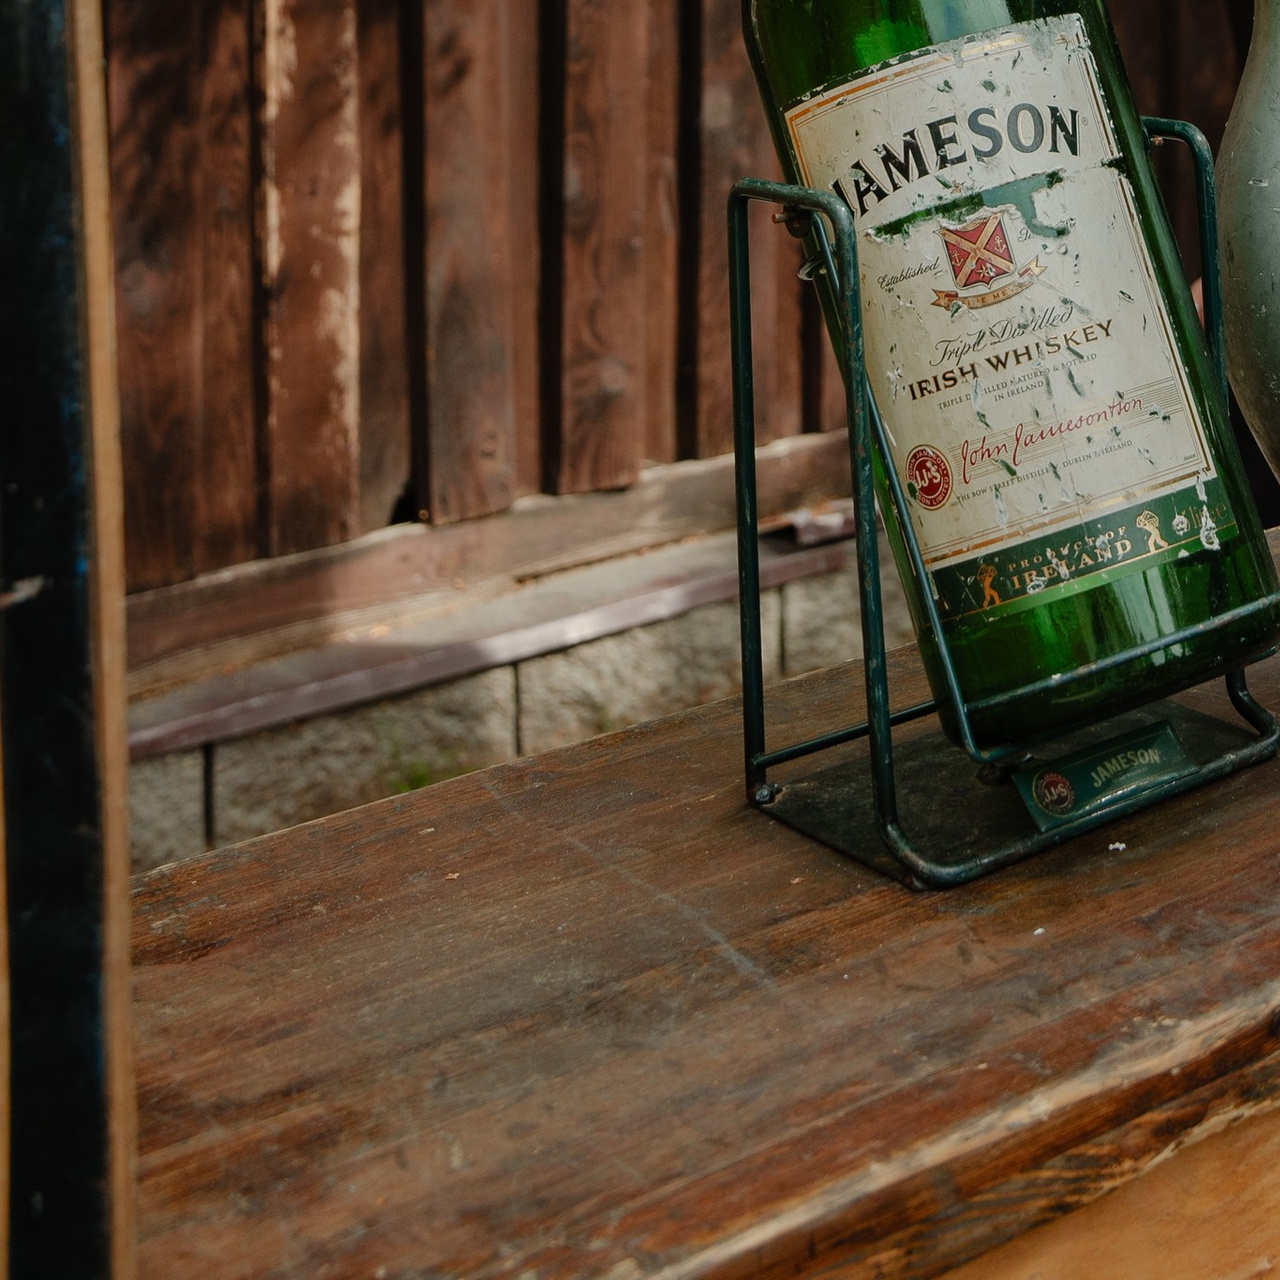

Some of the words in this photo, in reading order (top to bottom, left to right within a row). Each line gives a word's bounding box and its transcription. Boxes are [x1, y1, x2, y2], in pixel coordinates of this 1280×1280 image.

[832, 103, 1080, 220] JAMESON
[877, 259, 939, 289] Established
[907, 362, 980, 401] IRISH
[985, 319, 1114, 368] WHISKEY
[937, 395, 964, 410] TRIPLE
[993, 393, 1005, 402] IN
[1006, 380, 1045, 398] IRELAND
[971, 486, 989, 498] BOW
[1062, 452, 1093, 468] DUBLIN
[1008, 536, 1096, 572] PRODUCT
[1104, 525, 1127, 541] OF
[1010, 538, 1134, 590] IRELAND
[1091, 747, 1161, 788] JAMESON
